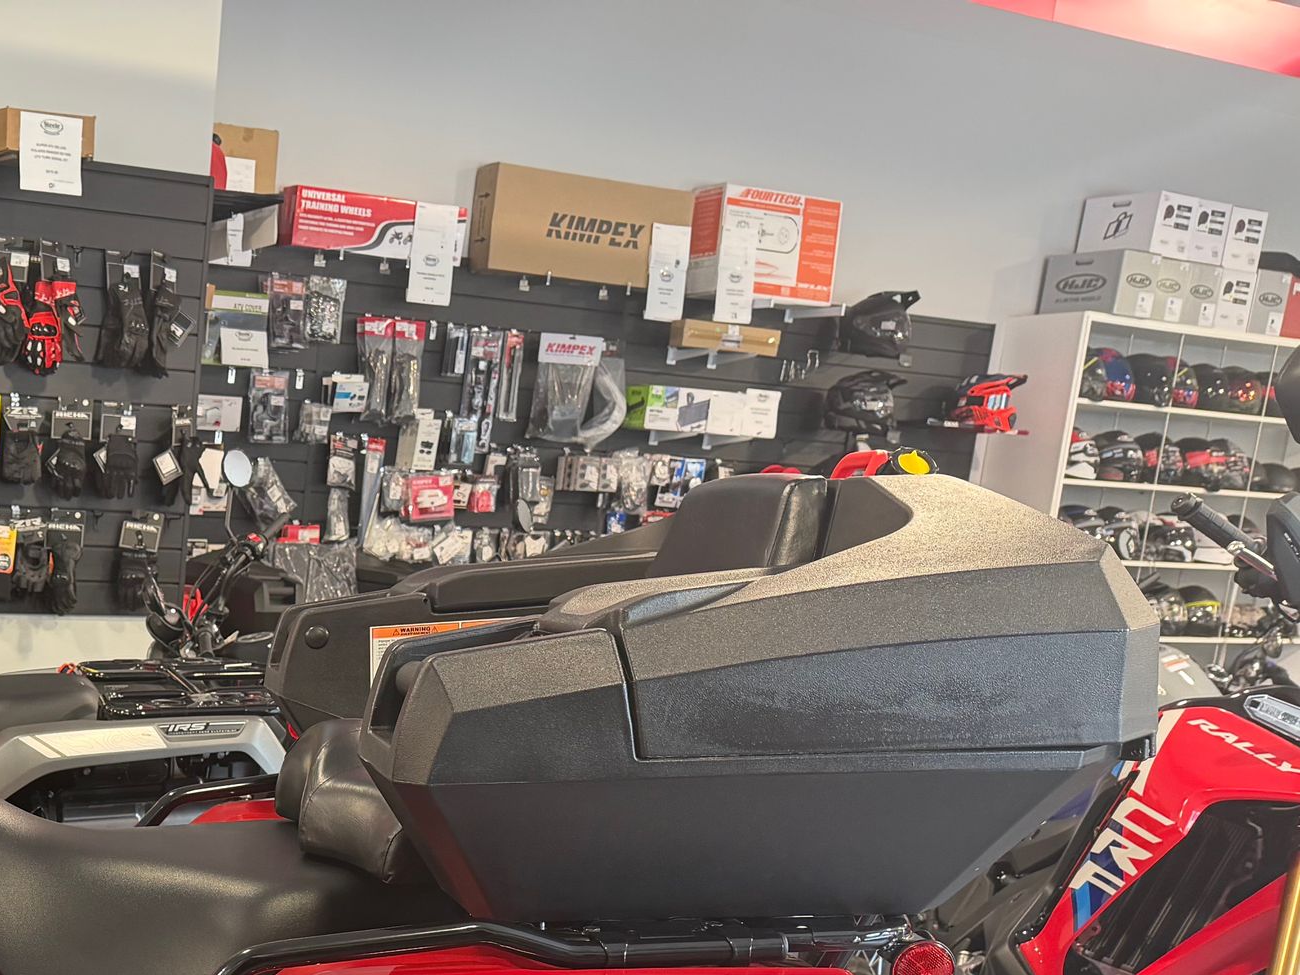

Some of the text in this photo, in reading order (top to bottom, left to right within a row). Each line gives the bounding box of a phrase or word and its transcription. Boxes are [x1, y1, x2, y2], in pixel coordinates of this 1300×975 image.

[302, 189, 346, 203] UNIVERSAL
[742, 188, 800, 206] FOURTECH
[301, 200, 372, 218] TRAINING WHEELS
[546, 212, 645, 250] KIMPEX
[546, 342, 596, 357] KIMPEX
[168, 722, 208, 732] IRS
[1068, 797, 1176, 896] CRF
